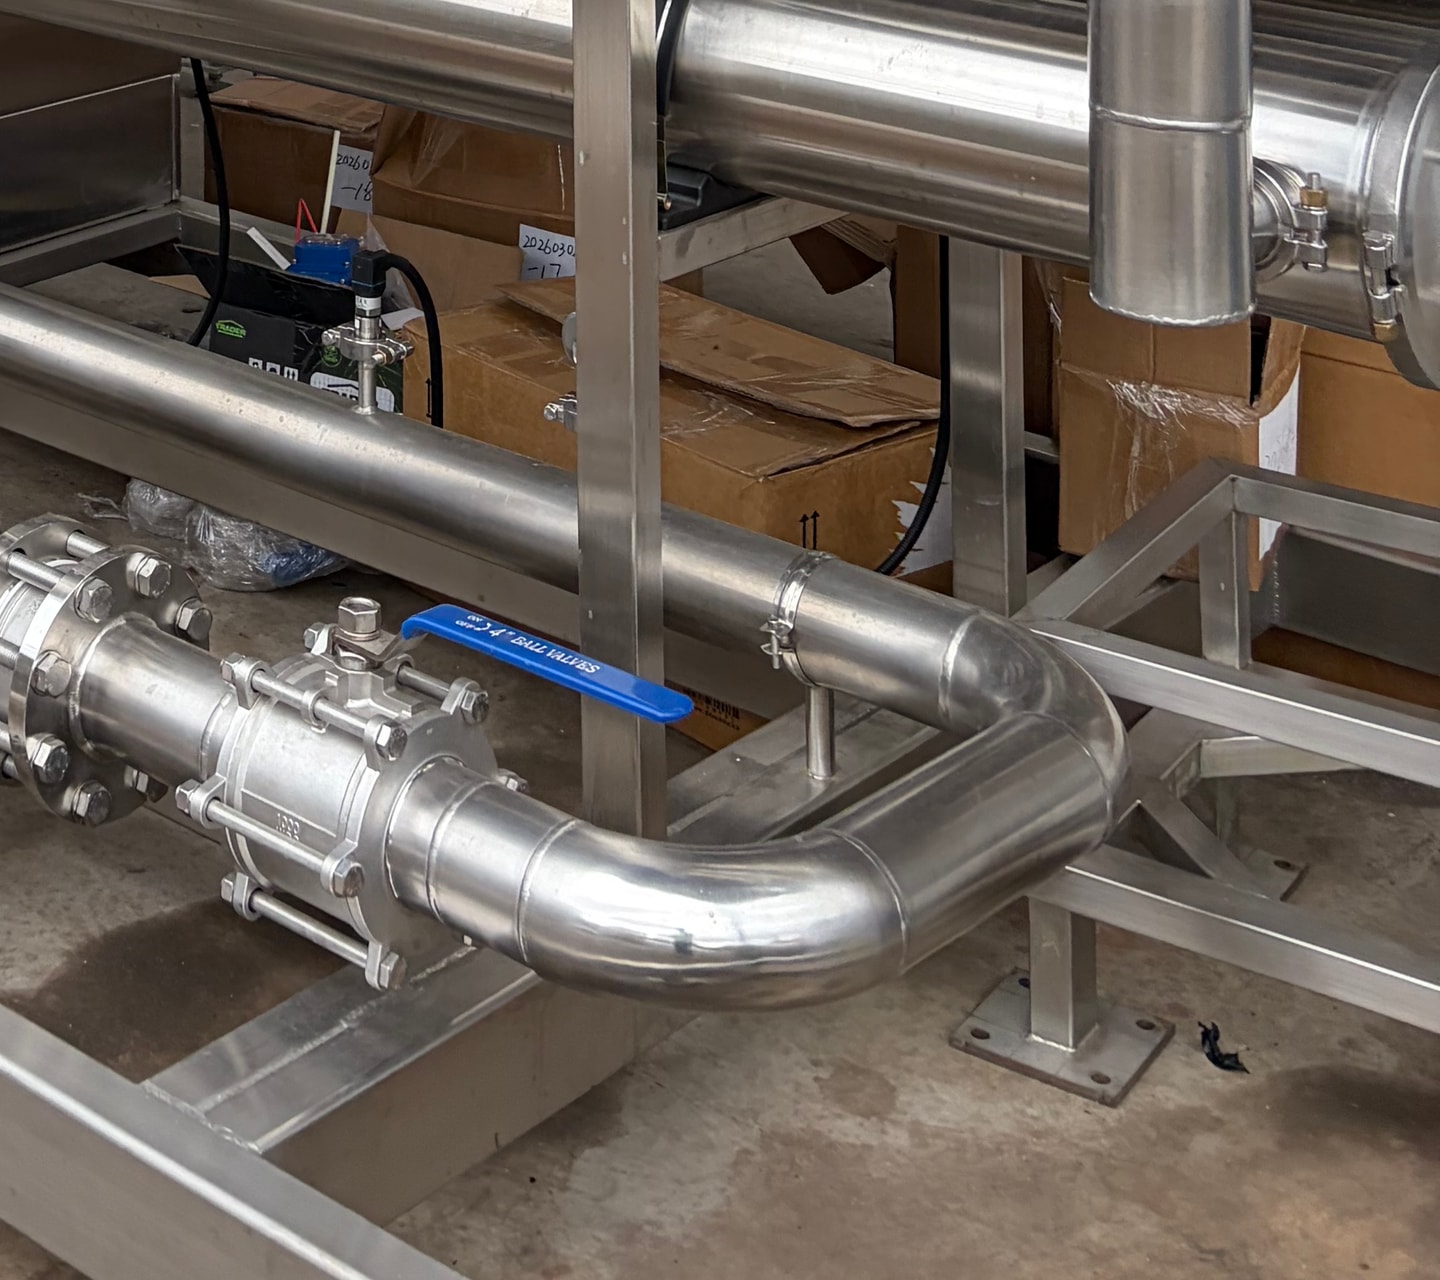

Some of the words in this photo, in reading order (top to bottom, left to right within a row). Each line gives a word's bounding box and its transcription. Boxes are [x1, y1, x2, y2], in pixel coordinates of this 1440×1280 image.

[523, 235, 575, 257] 2026030
[528, 263, 562, 279] -17
[510, 636, 548, 654] BALL
[546, 649, 601, 673] VALVES
